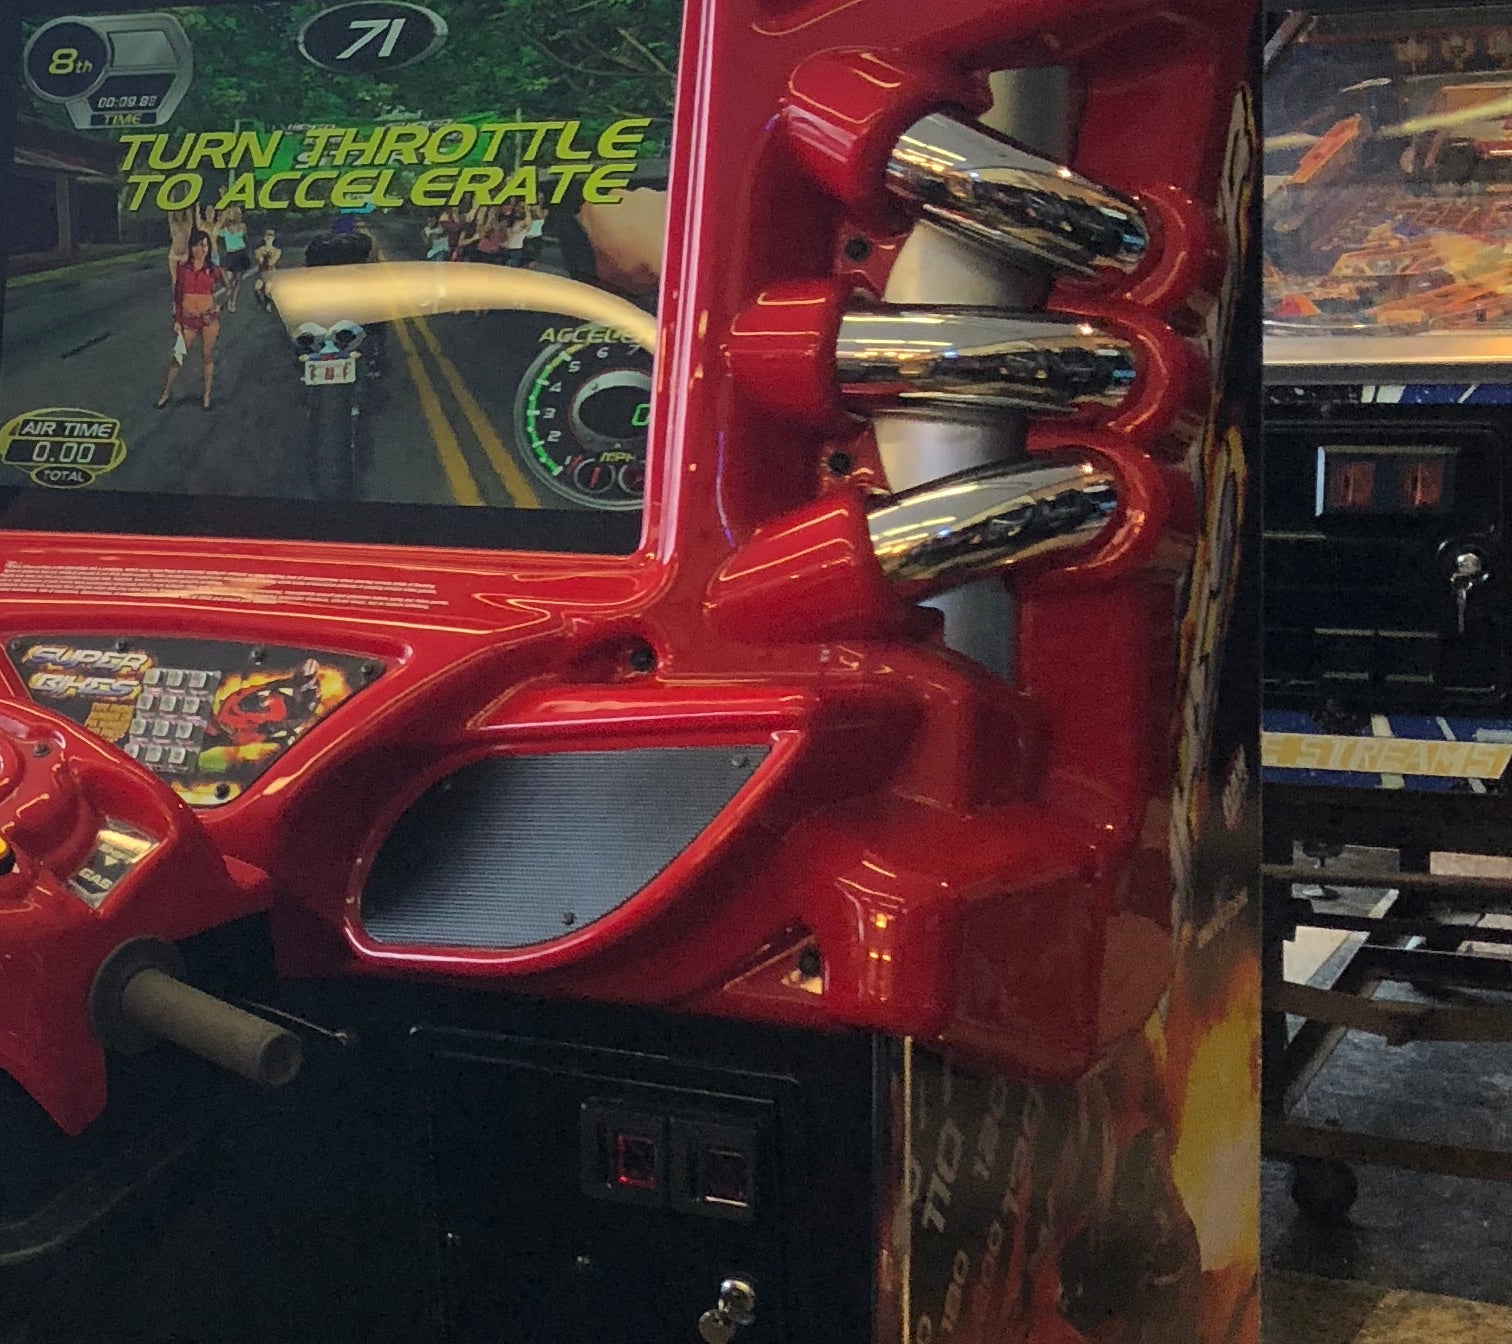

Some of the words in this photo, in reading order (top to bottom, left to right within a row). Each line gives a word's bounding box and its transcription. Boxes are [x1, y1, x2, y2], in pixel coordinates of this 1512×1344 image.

[335, 17, 407, 59] 71
[48, 47, 93, 75] 8th
[103, 113, 143, 125] TIME
[119, 129, 284, 171] TURN
[306, 117, 652, 167] THROTTLE
[127, 172, 203, 211] TO
[214, 163, 635, 210] ACCELERATE
[596, 346, 609, 358] 6
[568, 360, 581, 373] 5
[549, 381, 562, 393] 4
[542, 407, 557, 419] 3
[21, 421, 57, 435] AIR
[64, 422, 113, 437] TIME
[547, 430, 562, 442] 2
[32, 441, 96, 463] 0.00
[42, 470, 86, 482] TOTAL
[31, 646, 149, 671] SUPER
[34, 672, 141, 698] BIKES
[78, 867, 113, 890] GAS
